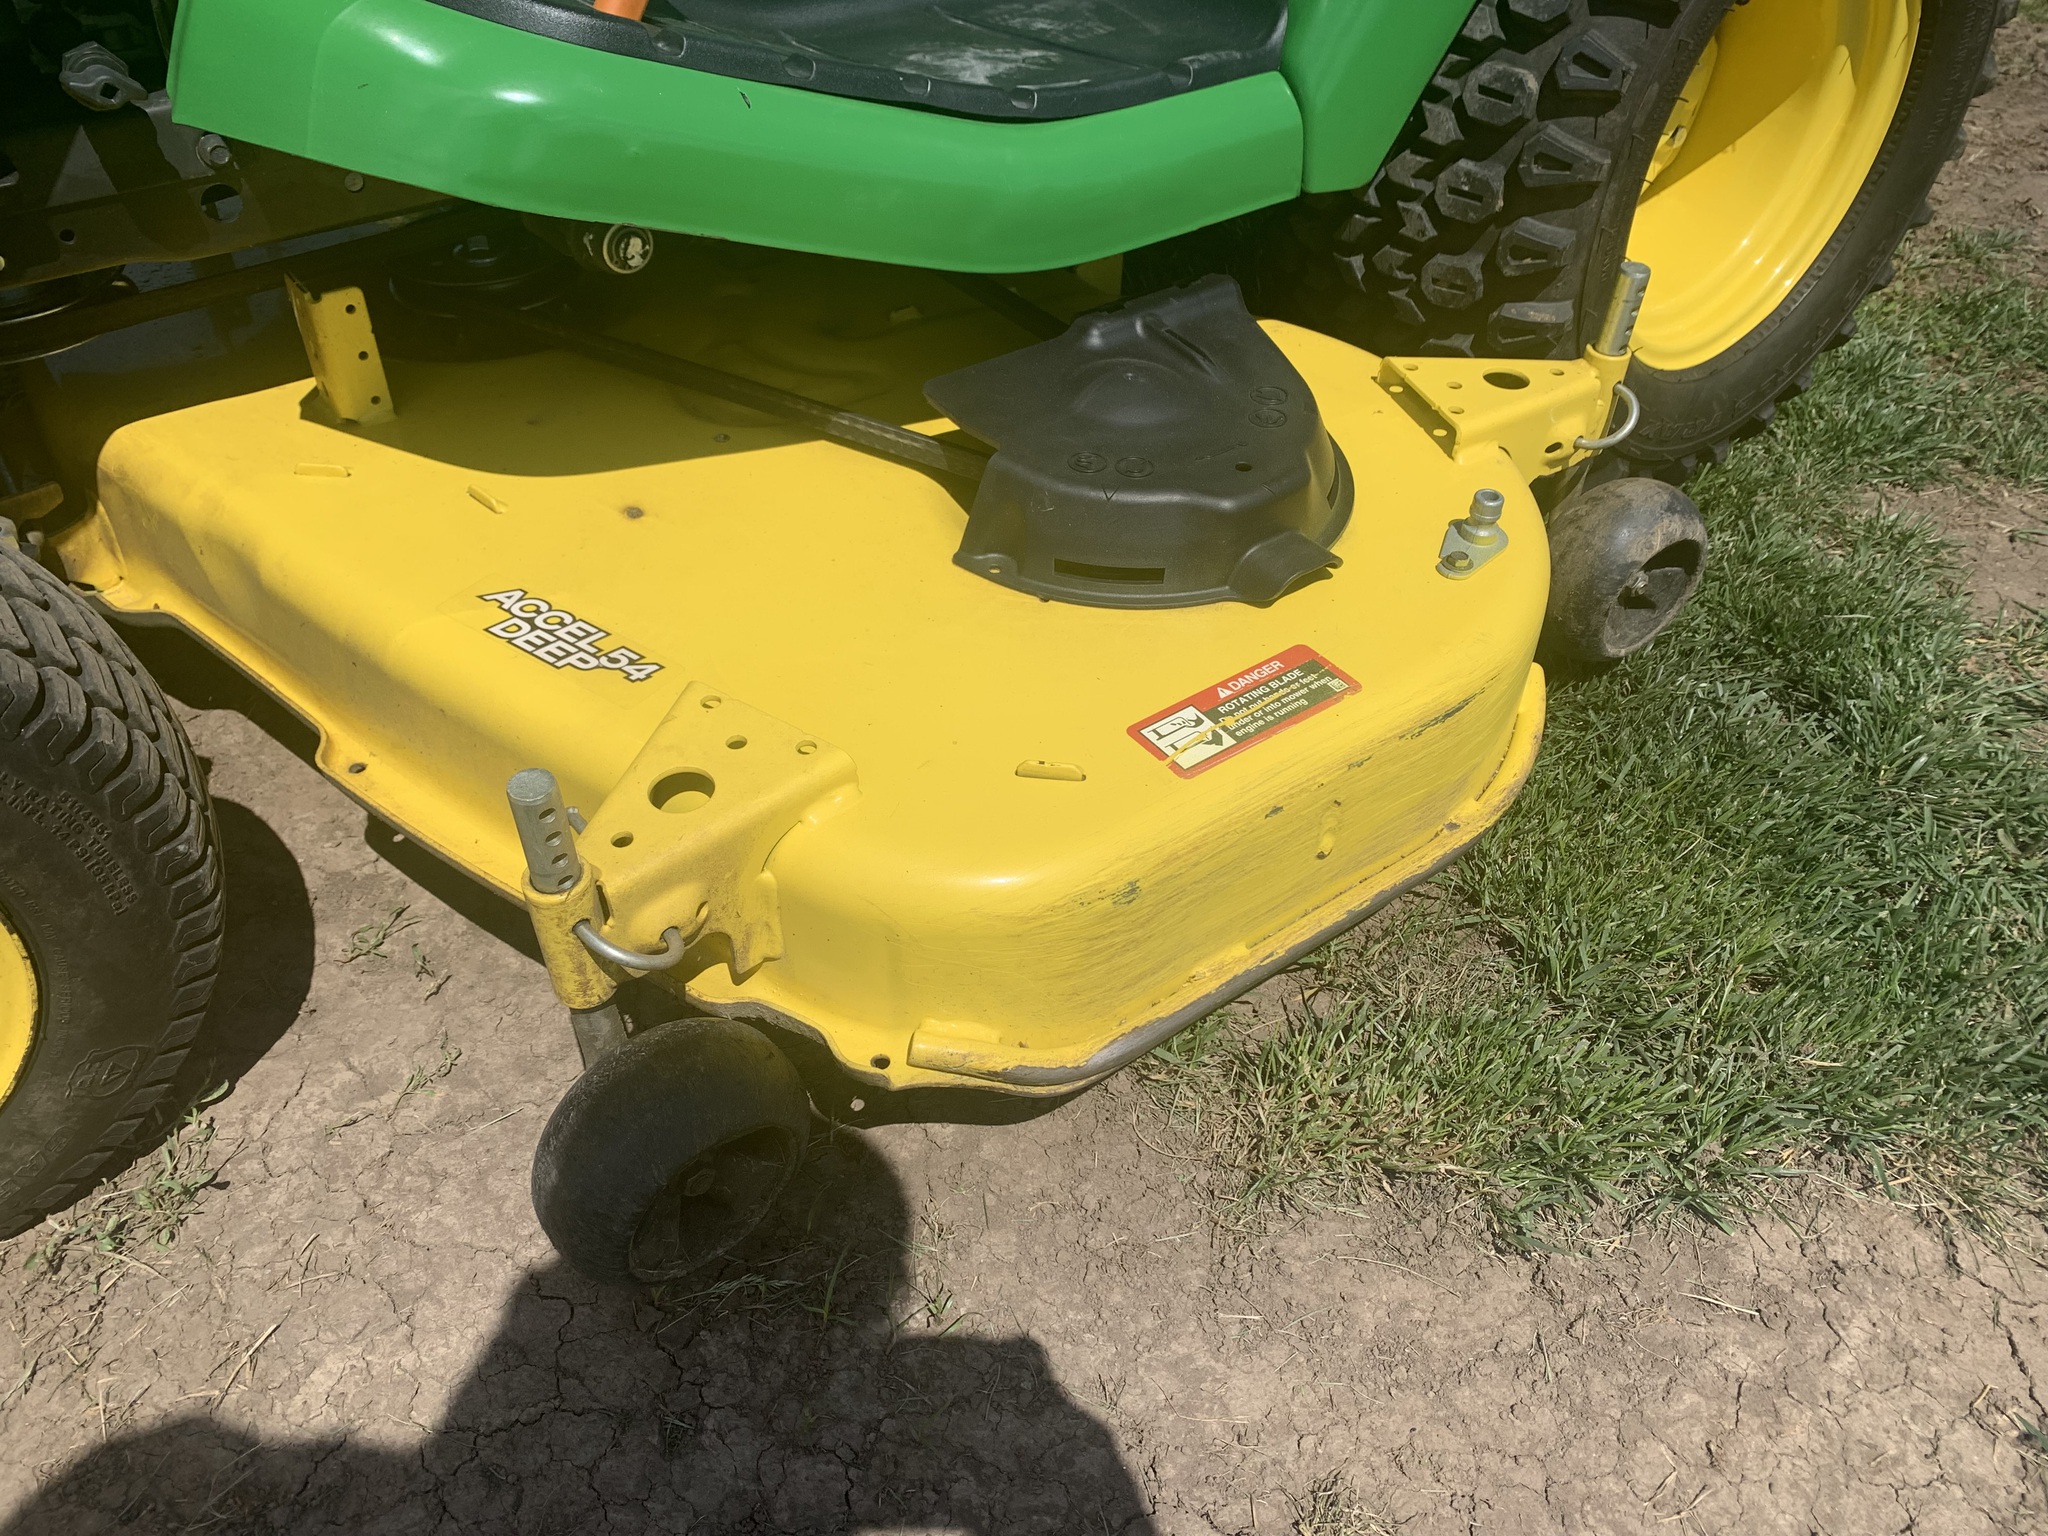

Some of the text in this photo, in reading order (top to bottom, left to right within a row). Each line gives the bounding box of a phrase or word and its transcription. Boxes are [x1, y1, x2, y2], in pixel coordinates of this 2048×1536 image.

[476, 588, 666, 683] ACCEL 54
[483, 616, 600, 671] DEEP
[1217, 668, 1304, 714] ROTATING BLADE
[1227, 660, 1285, 691] DANGER
[1253, 709, 1264, 718] or
[1262, 701, 1282, 713] into
[1281, 687, 1310, 704] mower
[1308, 676, 1333, 690] when
[1235, 698, 1309, 737] engine is running
[24, 786, 86, 836] RATING
[86, 836, 139, 905] TUBELESS
